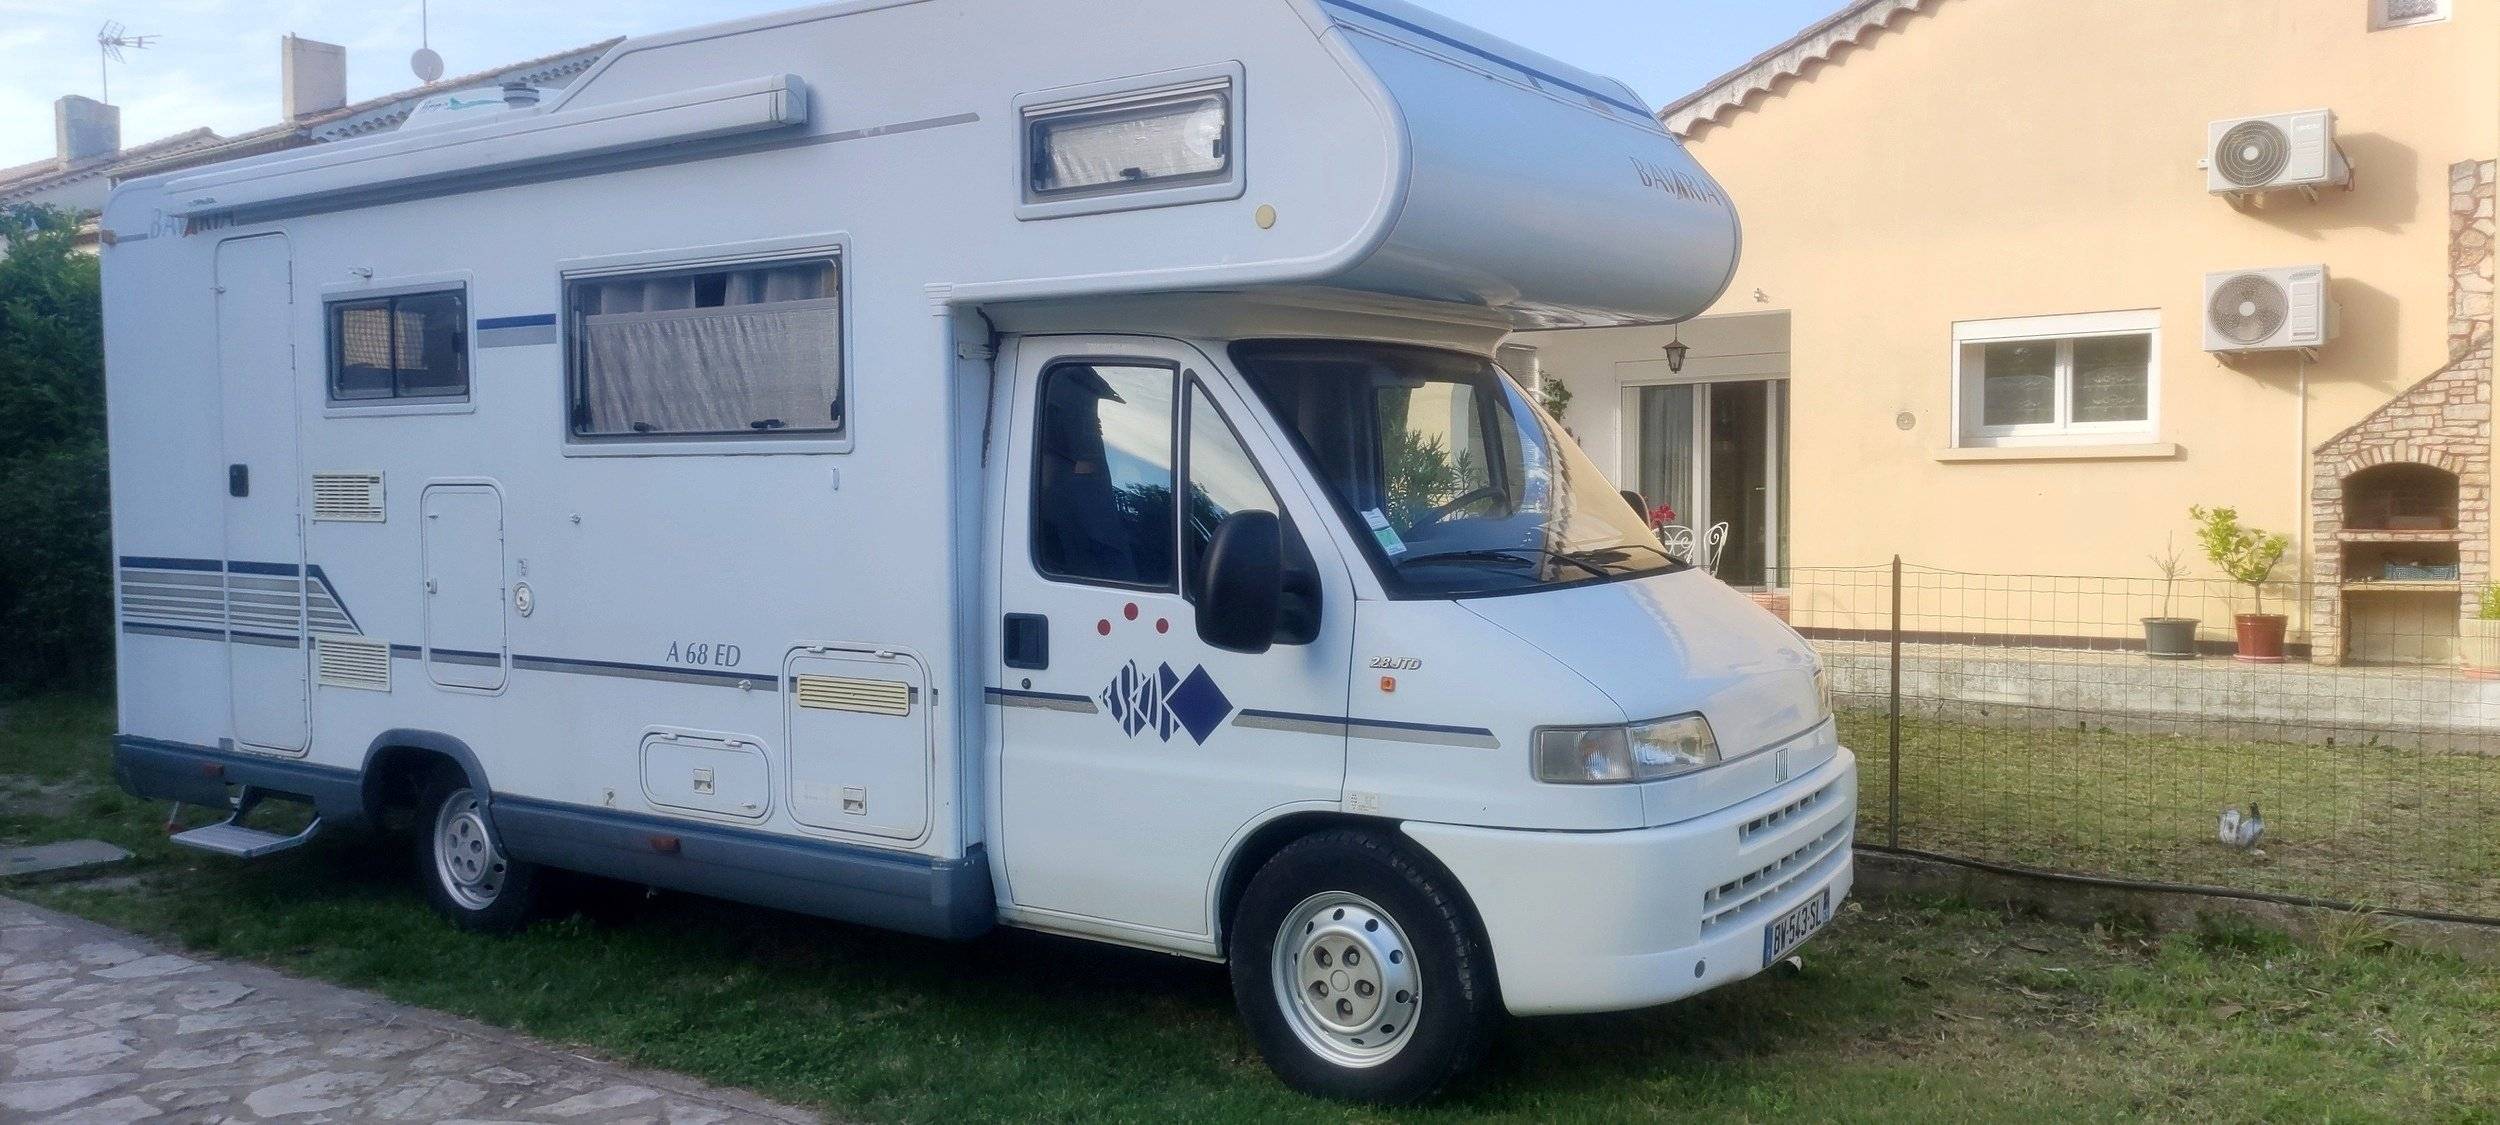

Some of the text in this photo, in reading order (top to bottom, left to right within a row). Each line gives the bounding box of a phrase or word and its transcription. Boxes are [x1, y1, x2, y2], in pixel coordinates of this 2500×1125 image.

[1628, 155, 1723, 207] BAVARIA
[666, 640, 742, 667] A 68 ED
